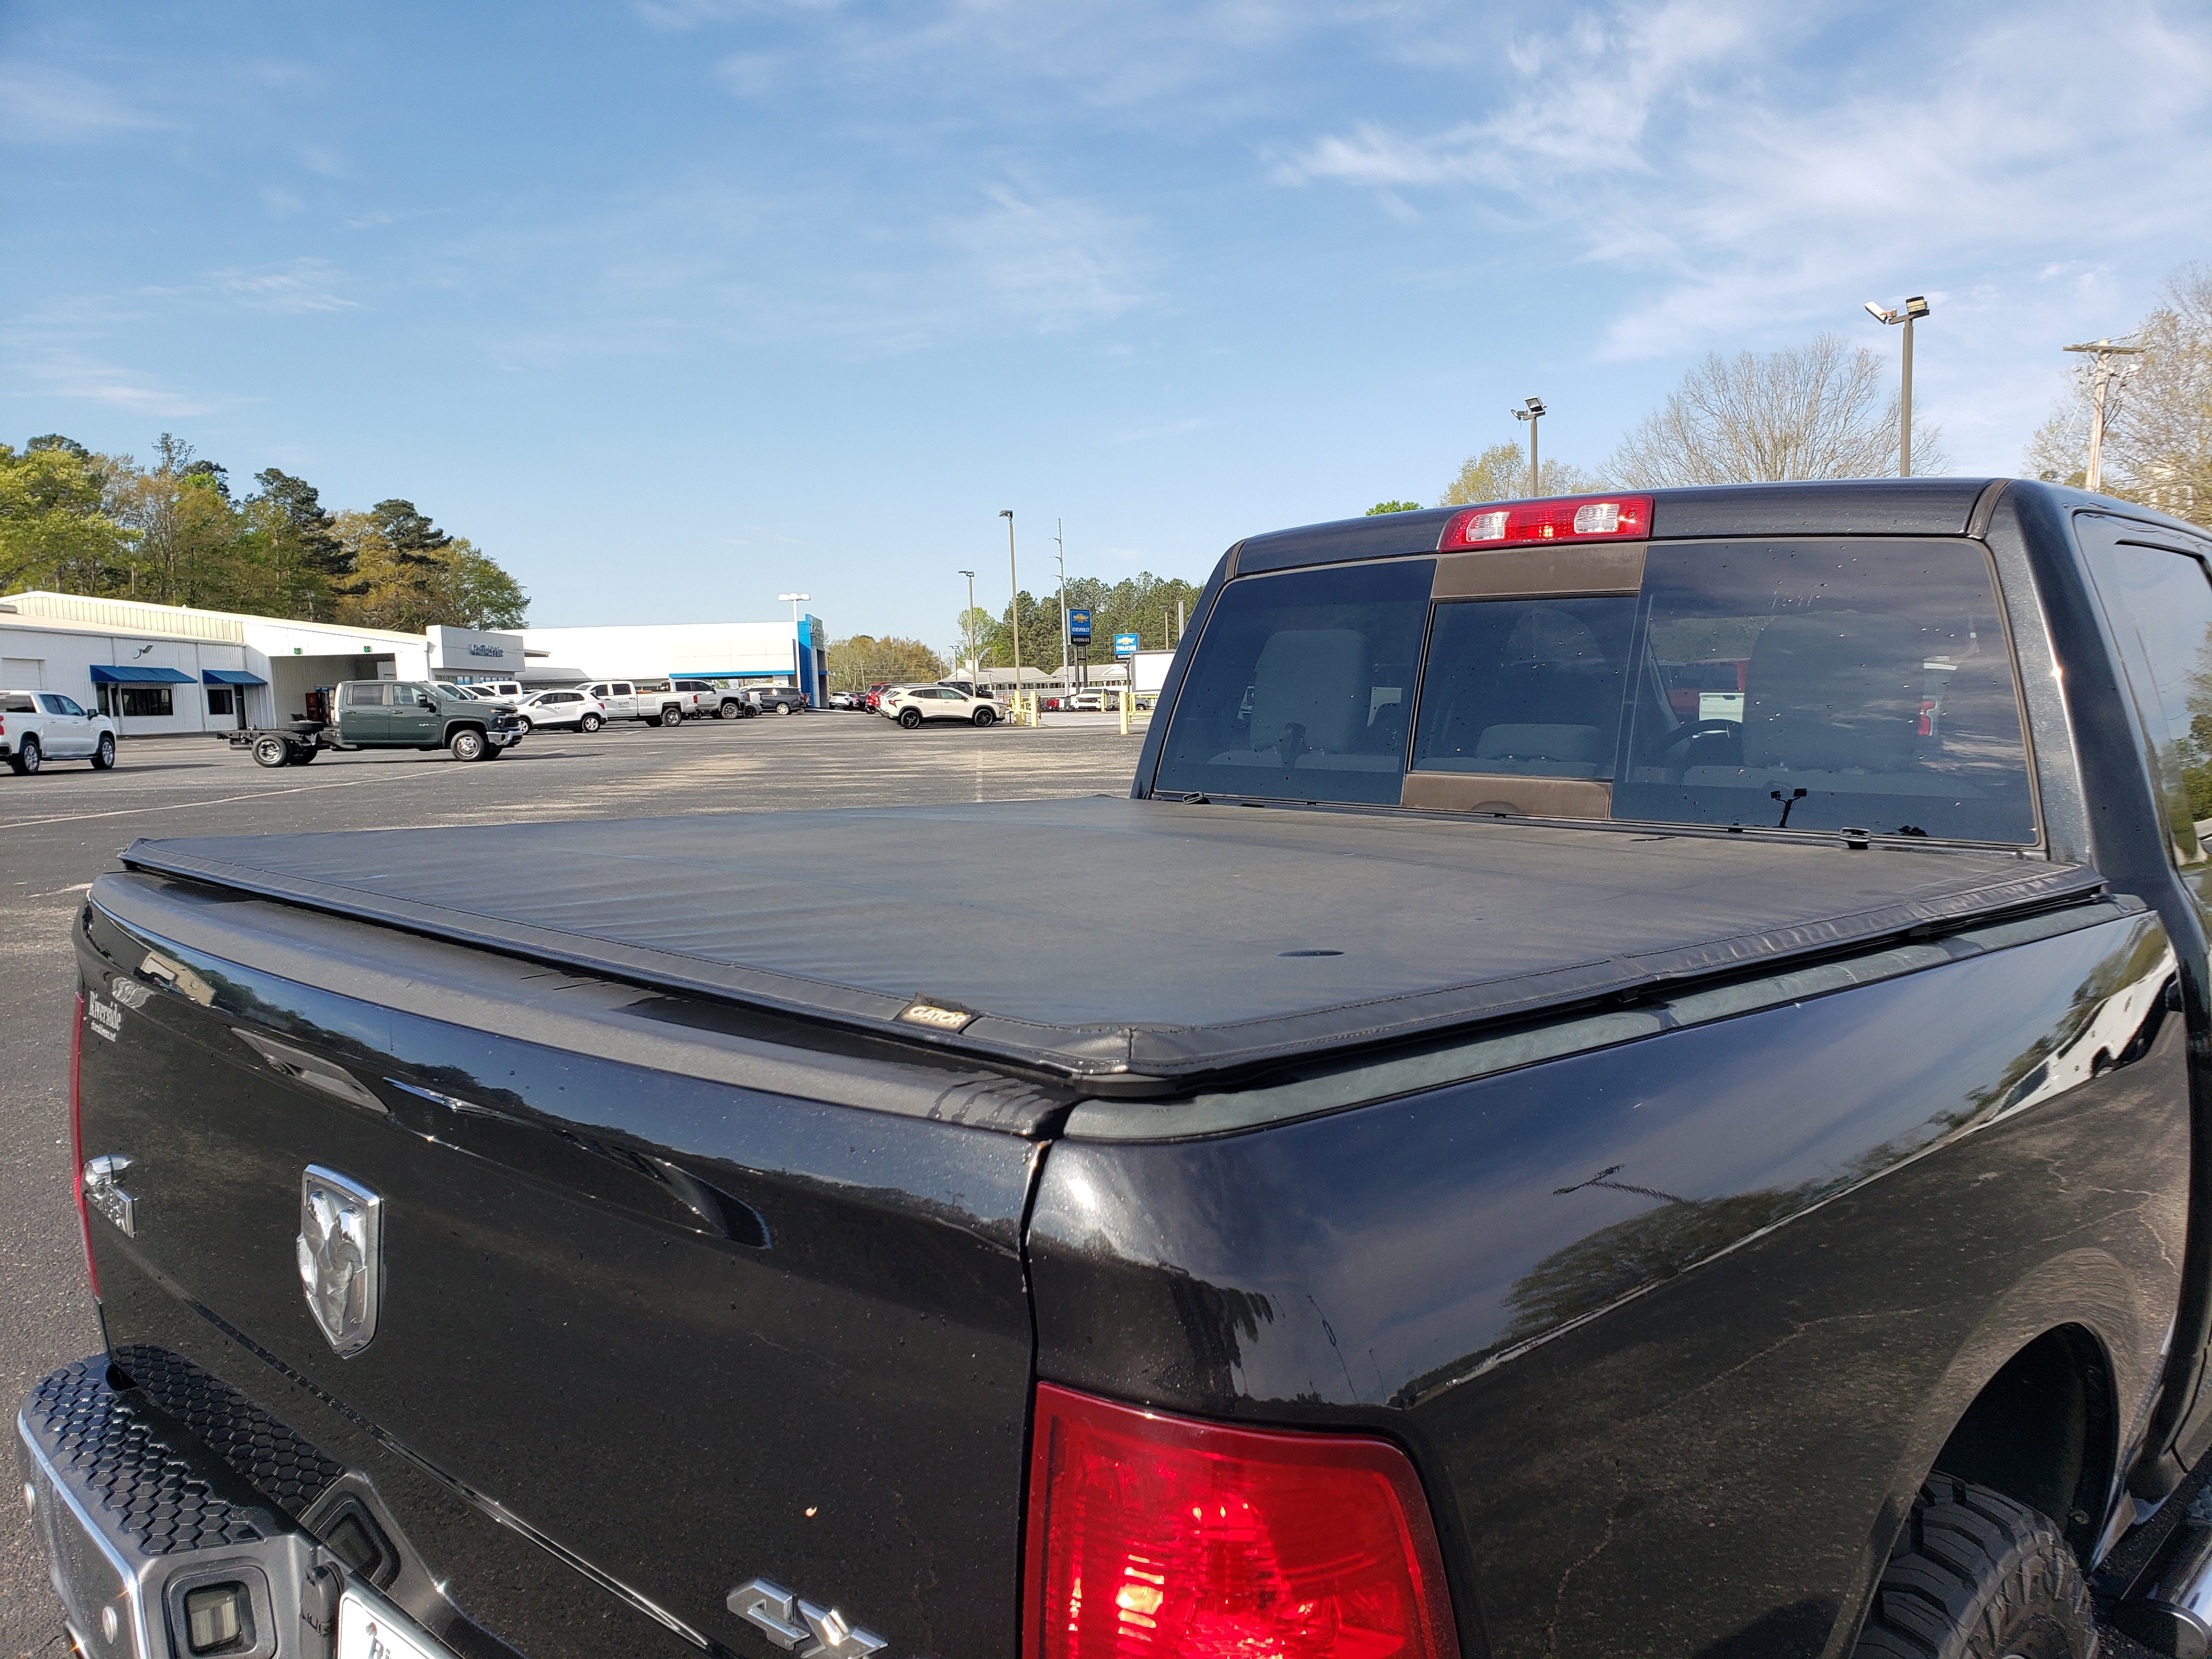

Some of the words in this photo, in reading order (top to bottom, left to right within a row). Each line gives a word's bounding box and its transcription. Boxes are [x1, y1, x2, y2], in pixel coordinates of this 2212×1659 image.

[88, 990, 121, 1031] Riverside
[910, 1006, 967, 1025] GATOR
[726, 1578, 889, 1659] 4X
